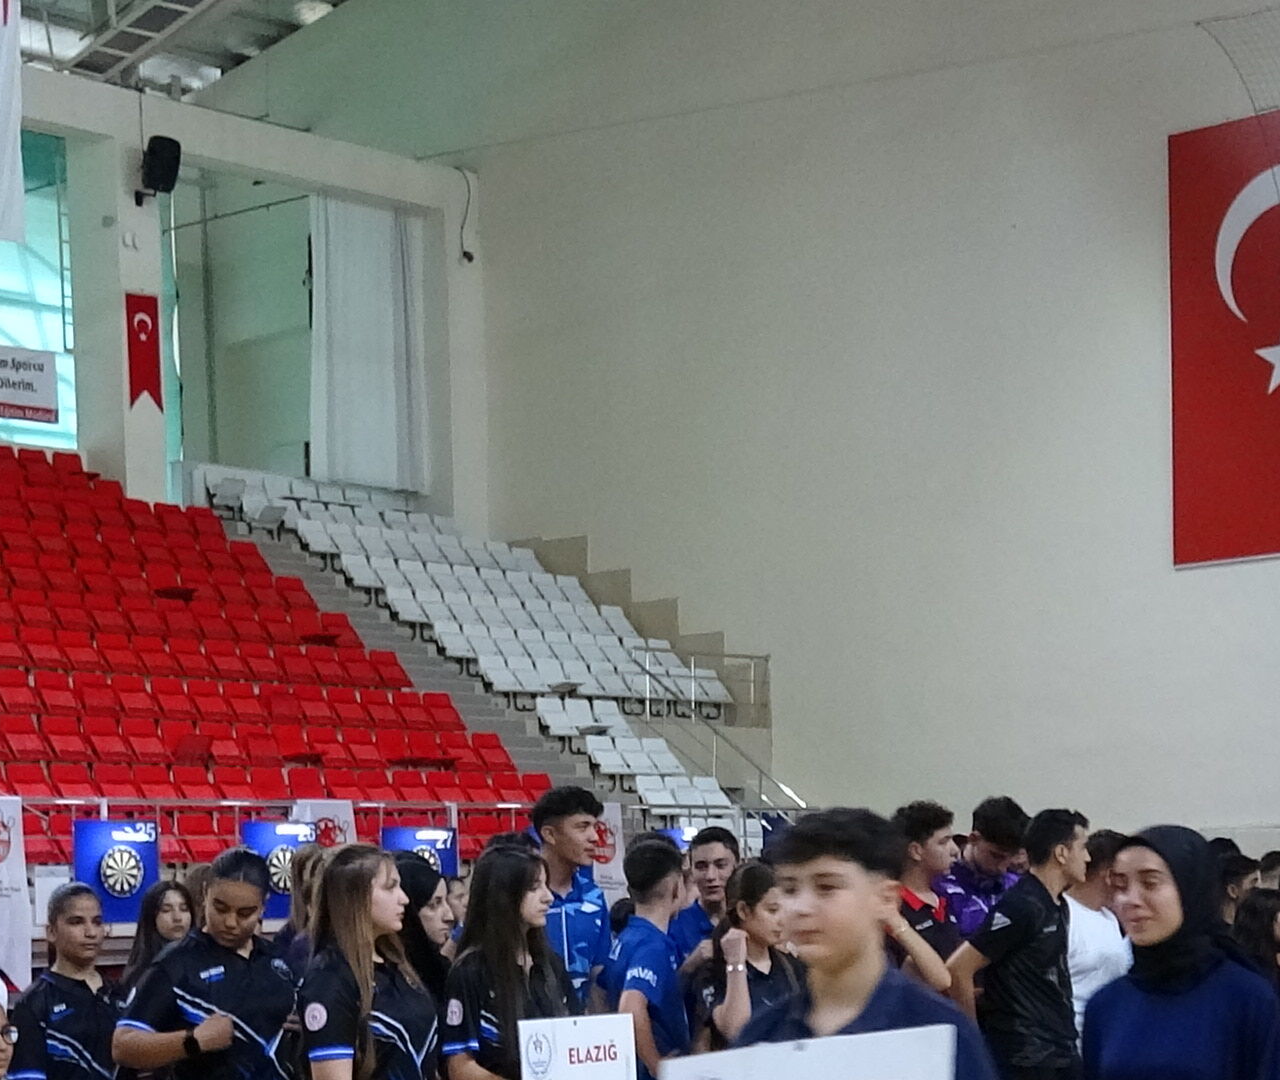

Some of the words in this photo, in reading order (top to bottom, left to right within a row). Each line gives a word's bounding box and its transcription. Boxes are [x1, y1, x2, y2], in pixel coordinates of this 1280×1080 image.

[9, 357, 45, 374] Sporcu
[135, 822, 156, 842] 25
[568, 1039, 618, 1065] ELAZIĞ
